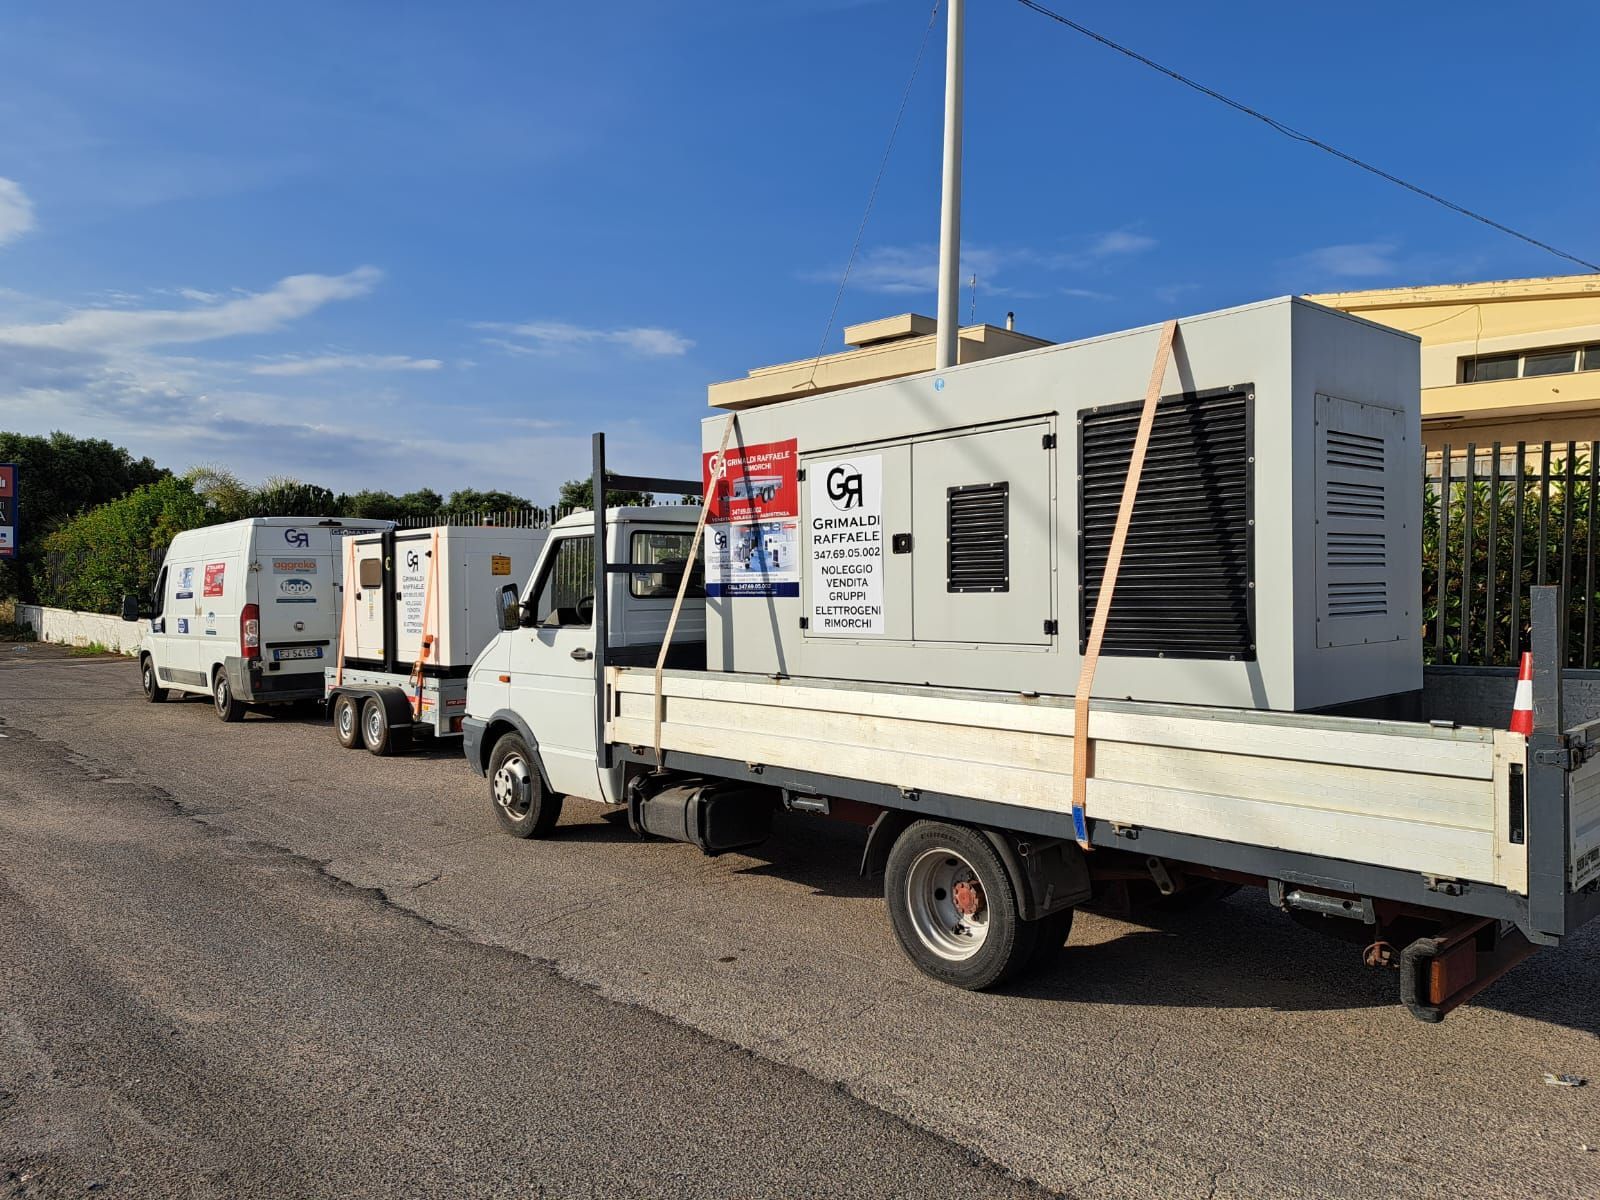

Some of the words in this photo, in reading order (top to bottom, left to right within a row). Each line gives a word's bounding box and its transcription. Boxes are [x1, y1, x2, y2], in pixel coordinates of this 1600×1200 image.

[727, 456, 757, 466] GRIMALDI
[757, 450, 790, 462] RAFFAELE
[744, 462, 772, 472] RIMORCHI
[813, 515, 880, 530] GRIMALDI
[814, 531, 880, 545] RAFFAELE
[814, 547, 881, 560] 347.69.05.002
[273, 560, 316, 570] aggreko
[822, 564, 873, 575] NOLEGGIO
[282, 581, 311, 591] fiorio
[826, 578, 868, 588] VENDITA
[829, 592, 866, 601] GRUPPI
[815, 606, 881, 615] ELETTROGENI
[824, 618, 872, 628] RIMORCHI
